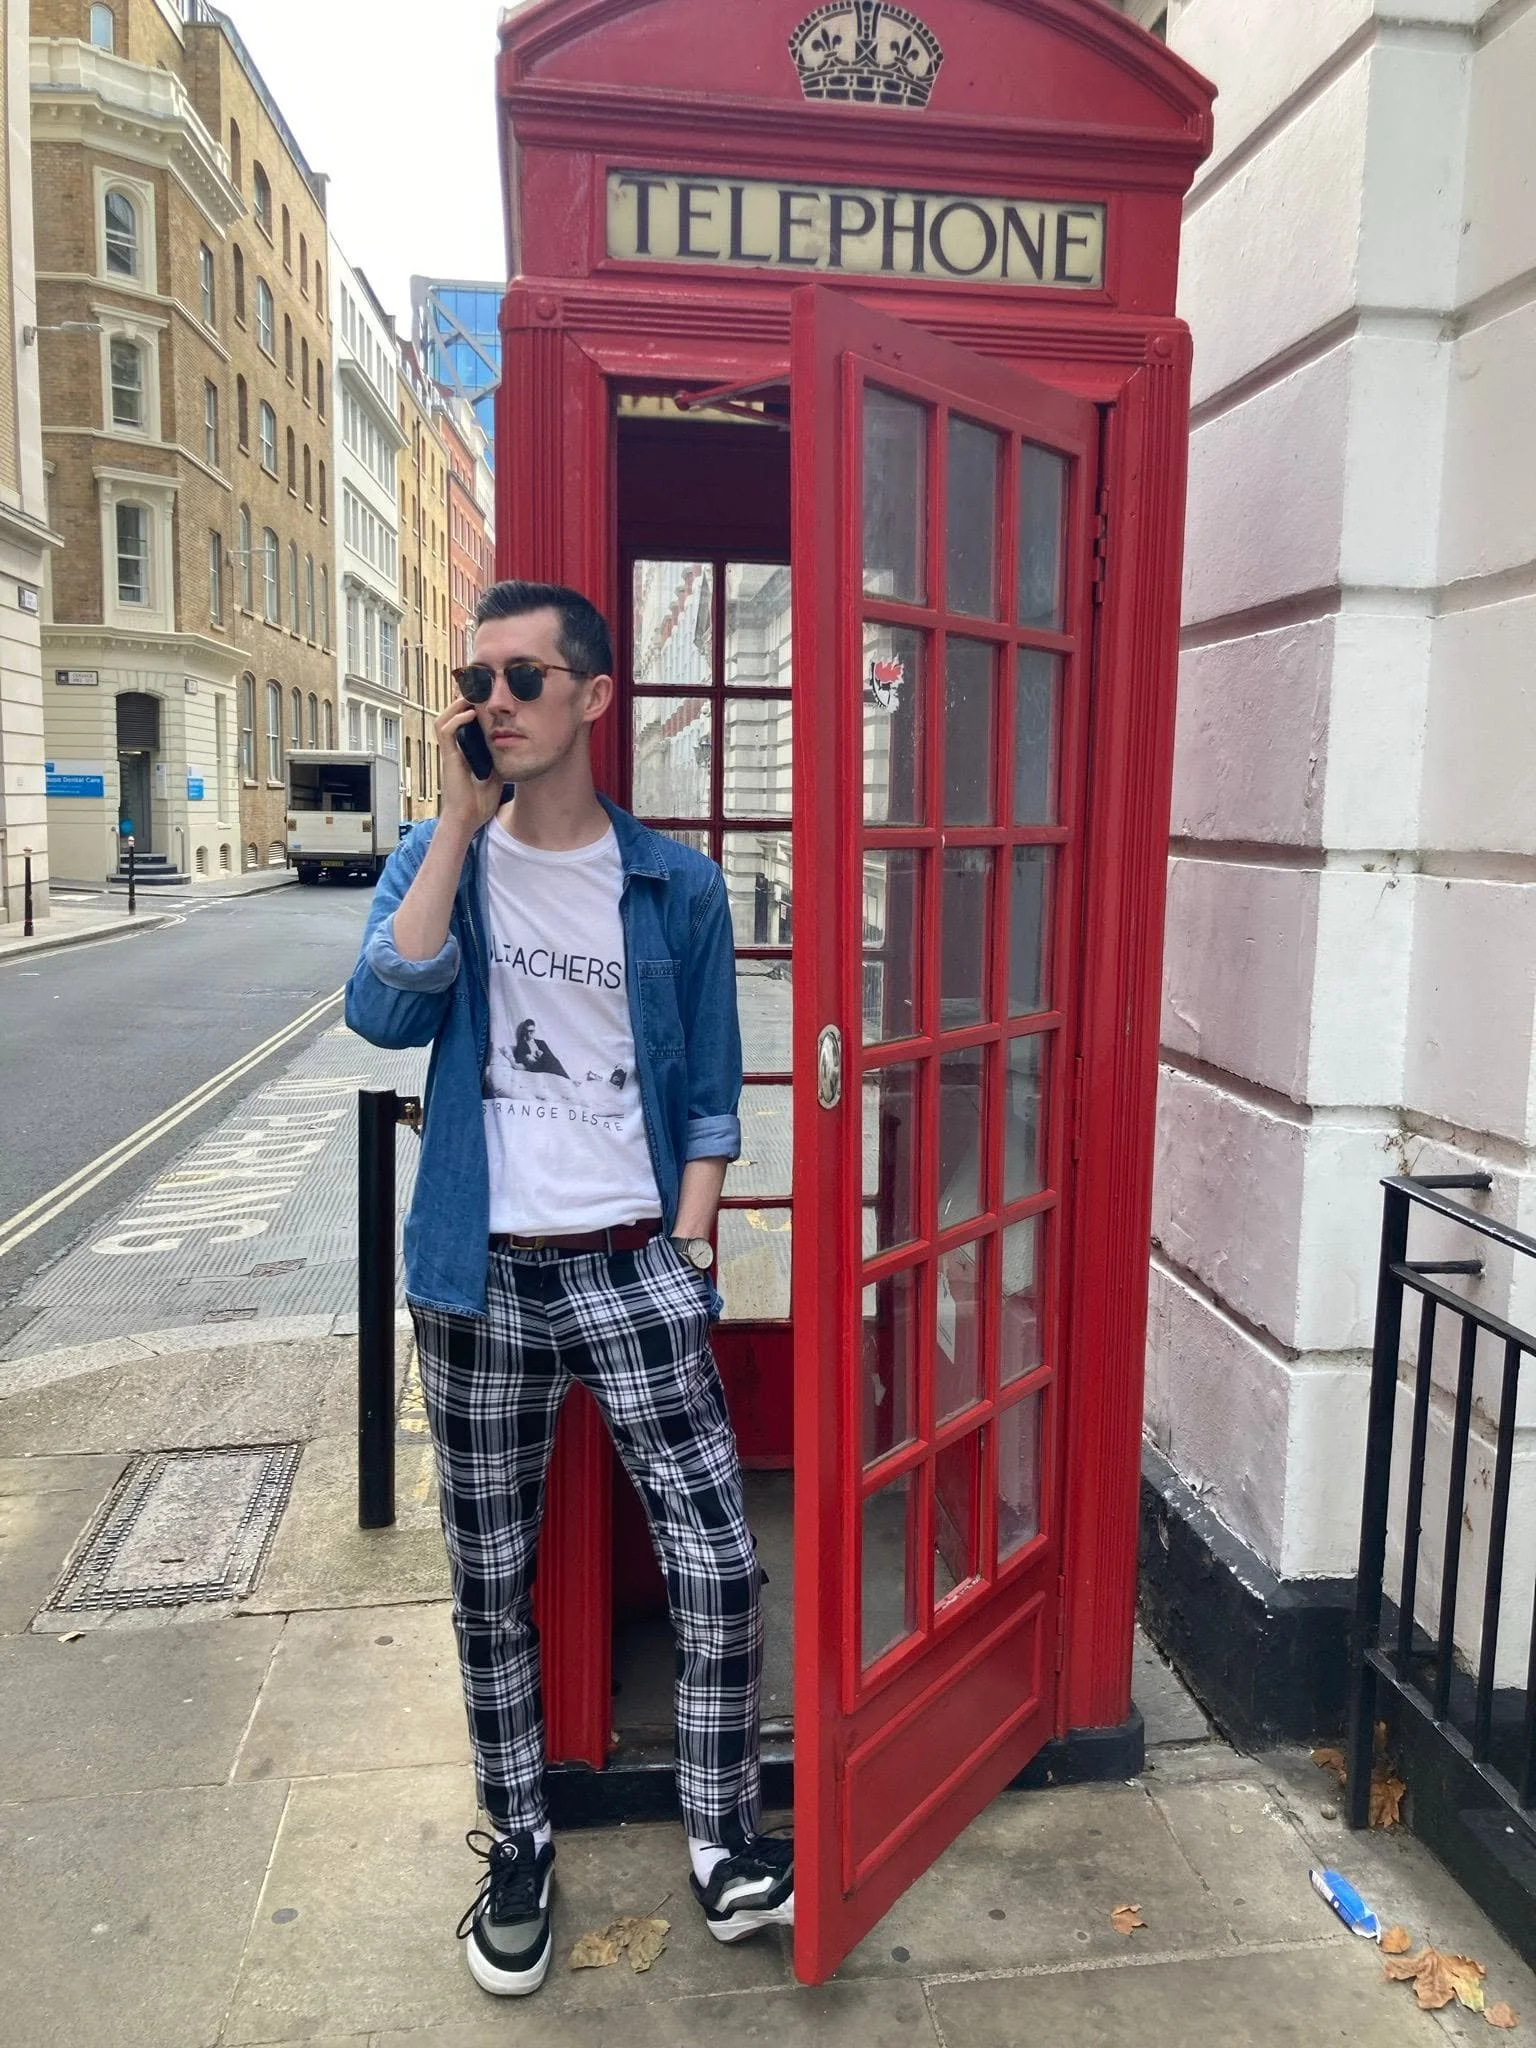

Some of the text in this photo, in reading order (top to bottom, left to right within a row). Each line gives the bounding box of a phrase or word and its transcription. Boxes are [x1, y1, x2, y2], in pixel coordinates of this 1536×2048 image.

[619, 178, 1096, 283] TELEPHONE
[489, 935, 622, 989] LACHERS
[482, 1103, 624, 1131] SRANGE DESRE
[91, 1074, 371, 1255] NO PARKING
[83, 1554, 108, 1575] POST
